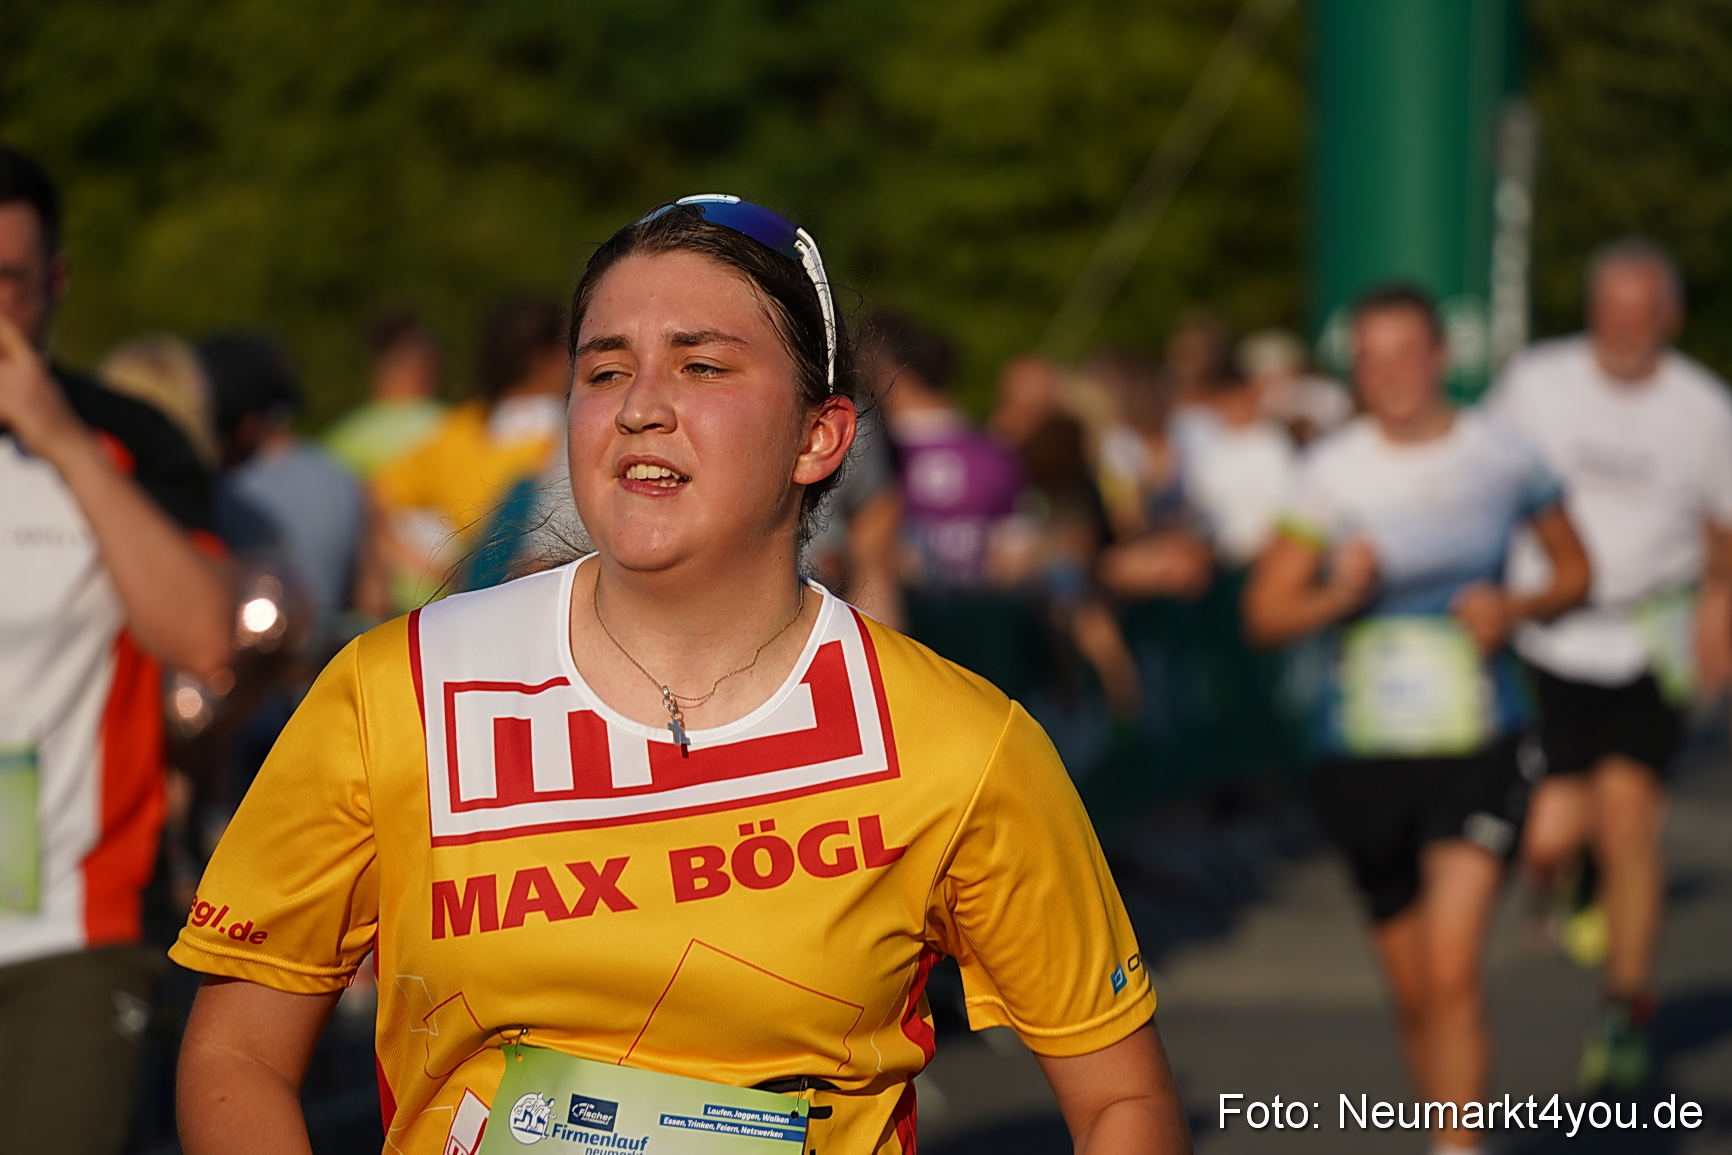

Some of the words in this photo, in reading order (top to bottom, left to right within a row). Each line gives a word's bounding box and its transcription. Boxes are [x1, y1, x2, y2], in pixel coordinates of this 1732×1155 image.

[431, 856, 638, 940] MAX
[668, 814, 909, 904] BÖGL
[578, 1104, 613, 1121] Fischer
[707, 1106, 733, 1118] Laufen,
[733, 1110, 761, 1121] Joggen,
[762, 1113, 790, 1124] Walken
[551, 1123, 650, 1151] Firmenlauf
[663, 1116, 687, 1127] Essen,
[687, 1119, 715, 1131] Trinken,
[715, 1122, 740, 1134] Feiern,
[740, 1126, 784, 1138] Netzwerken
